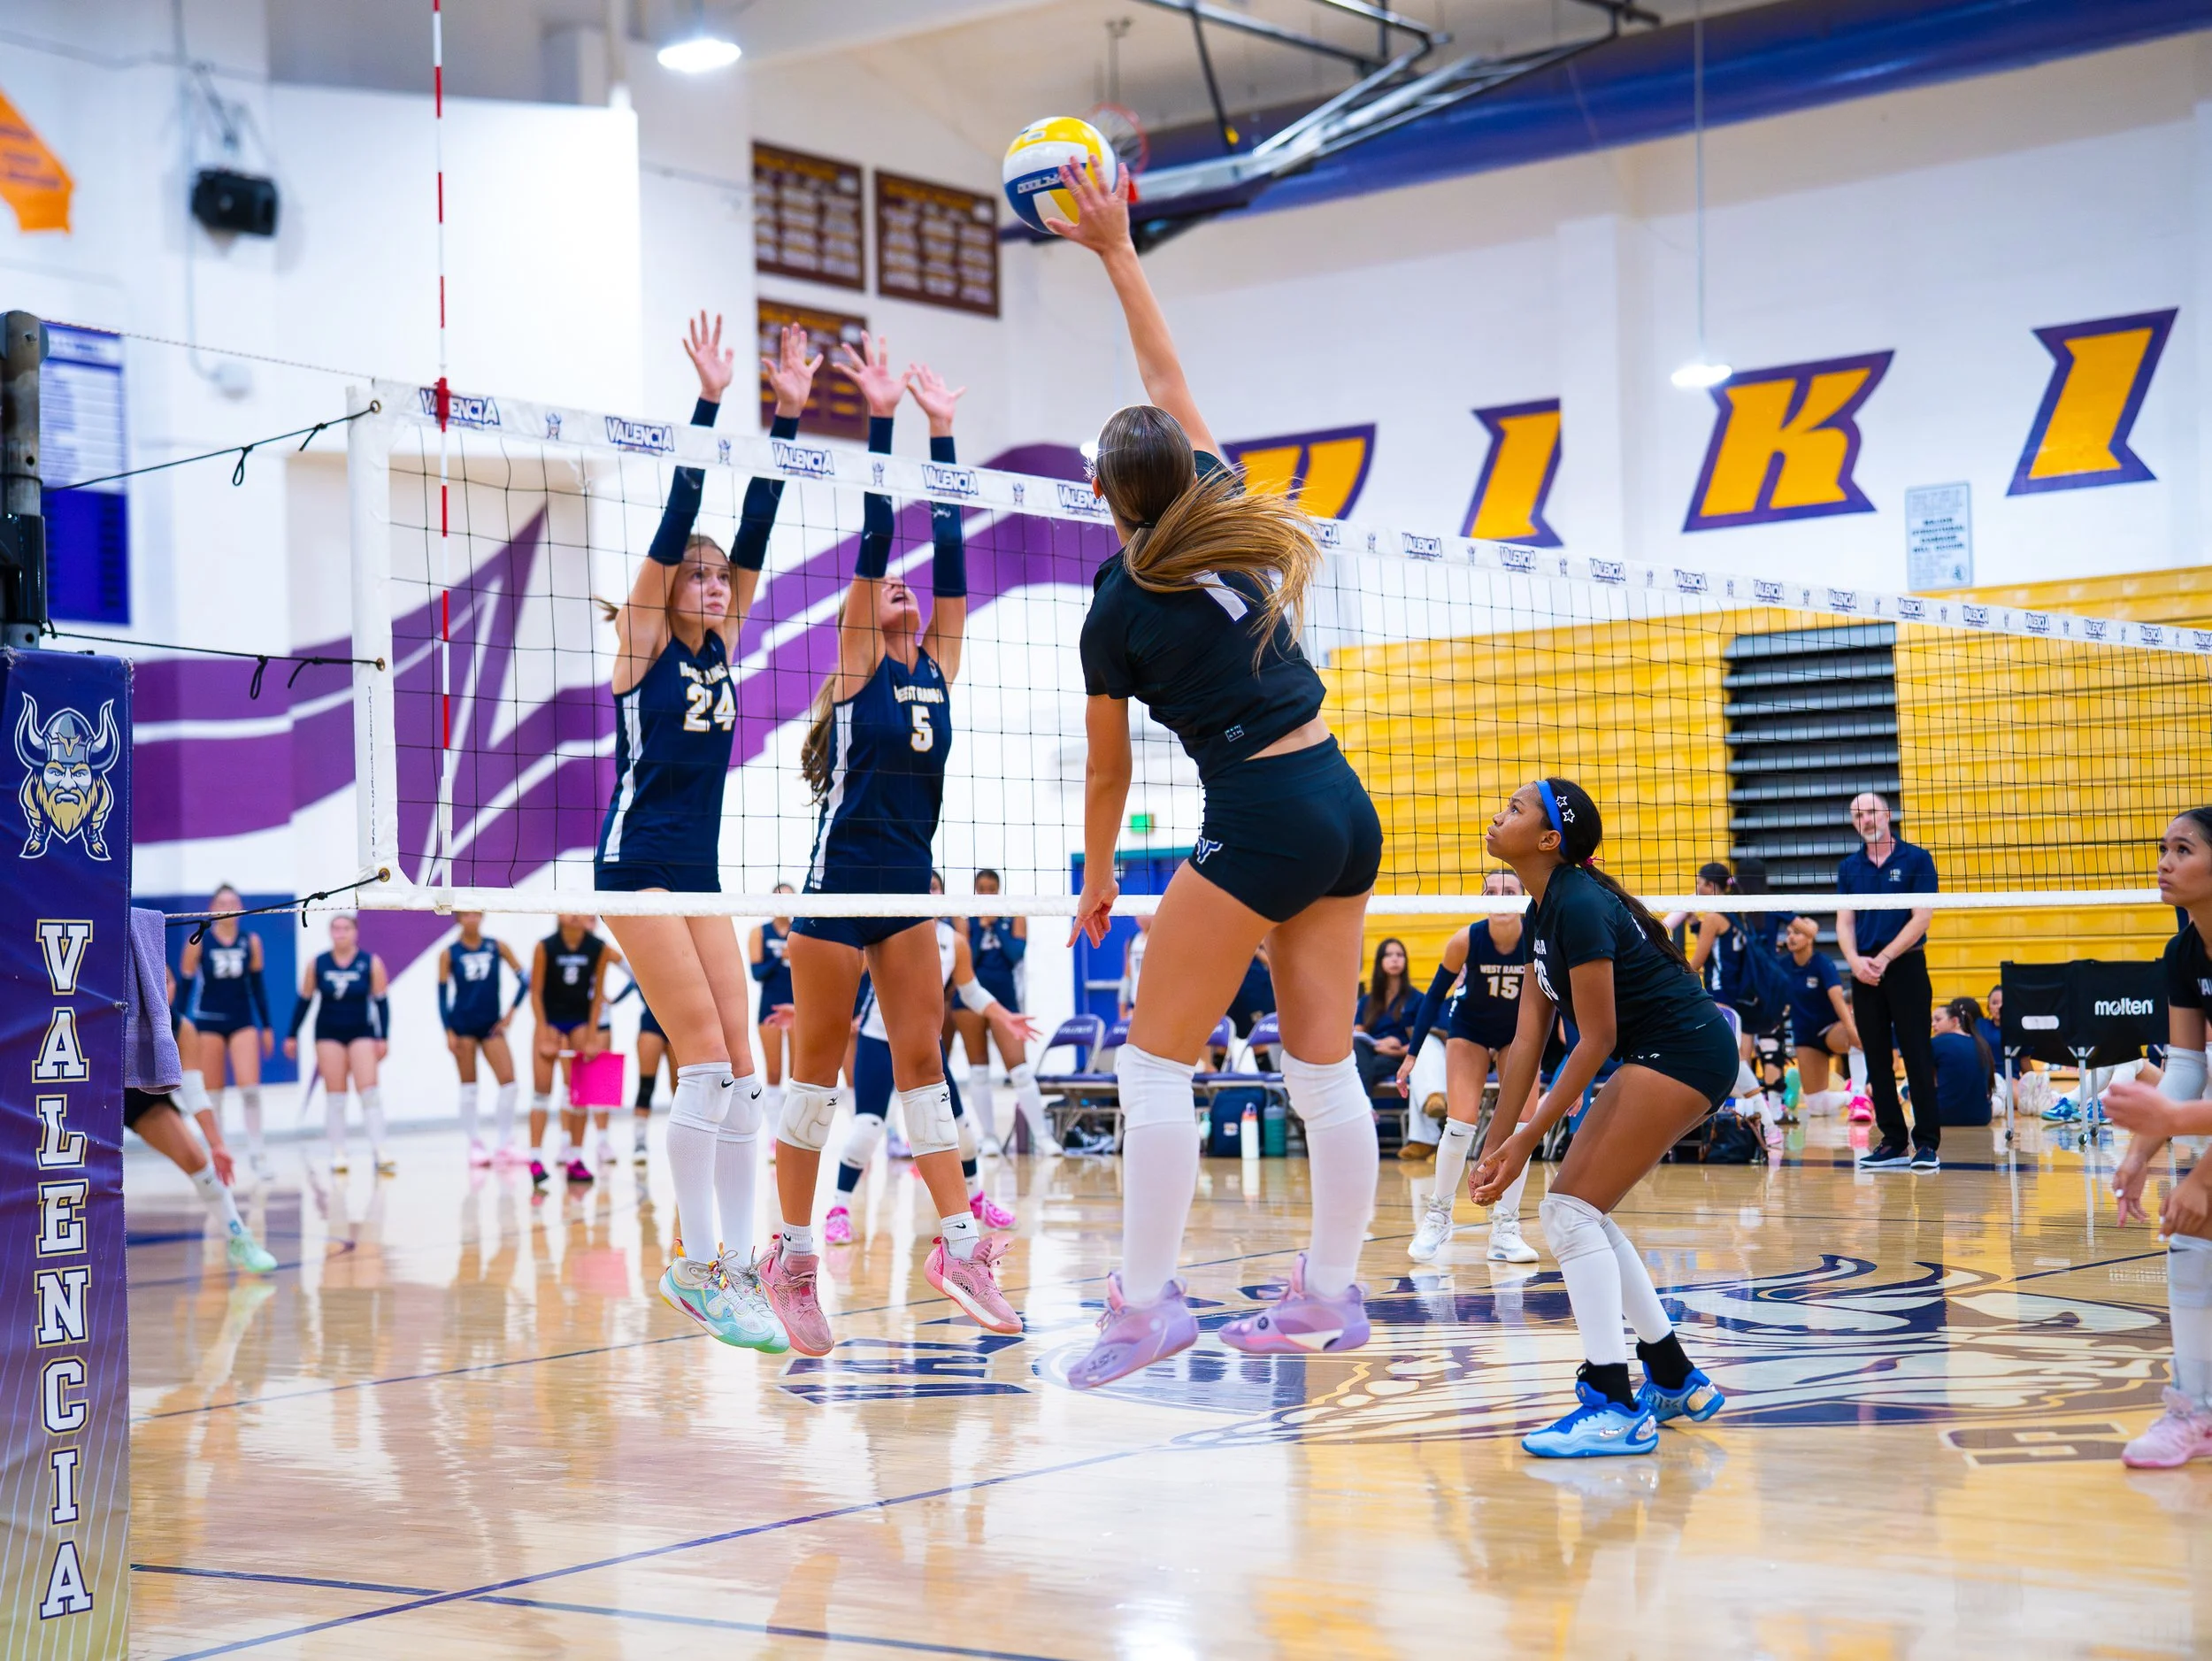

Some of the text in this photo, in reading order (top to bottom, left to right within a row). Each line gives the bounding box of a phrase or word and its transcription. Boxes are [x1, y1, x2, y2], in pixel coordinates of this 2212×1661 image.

[604, 416, 675, 452] VALENCIA
[772, 442, 834, 476] VALENCIA
[921, 464, 979, 496] VALENCIA
[1402, 533, 1442, 558] VALENCIA
[683, 681, 737, 733] 24
[910, 704, 933, 752] 5
[1479, 965, 1525, 974] WEST RANC
[1487, 975, 1519, 1000] 15
[2094, 997, 2154, 1016] molten
[32, 919, 93, 1620] VALENCIA
